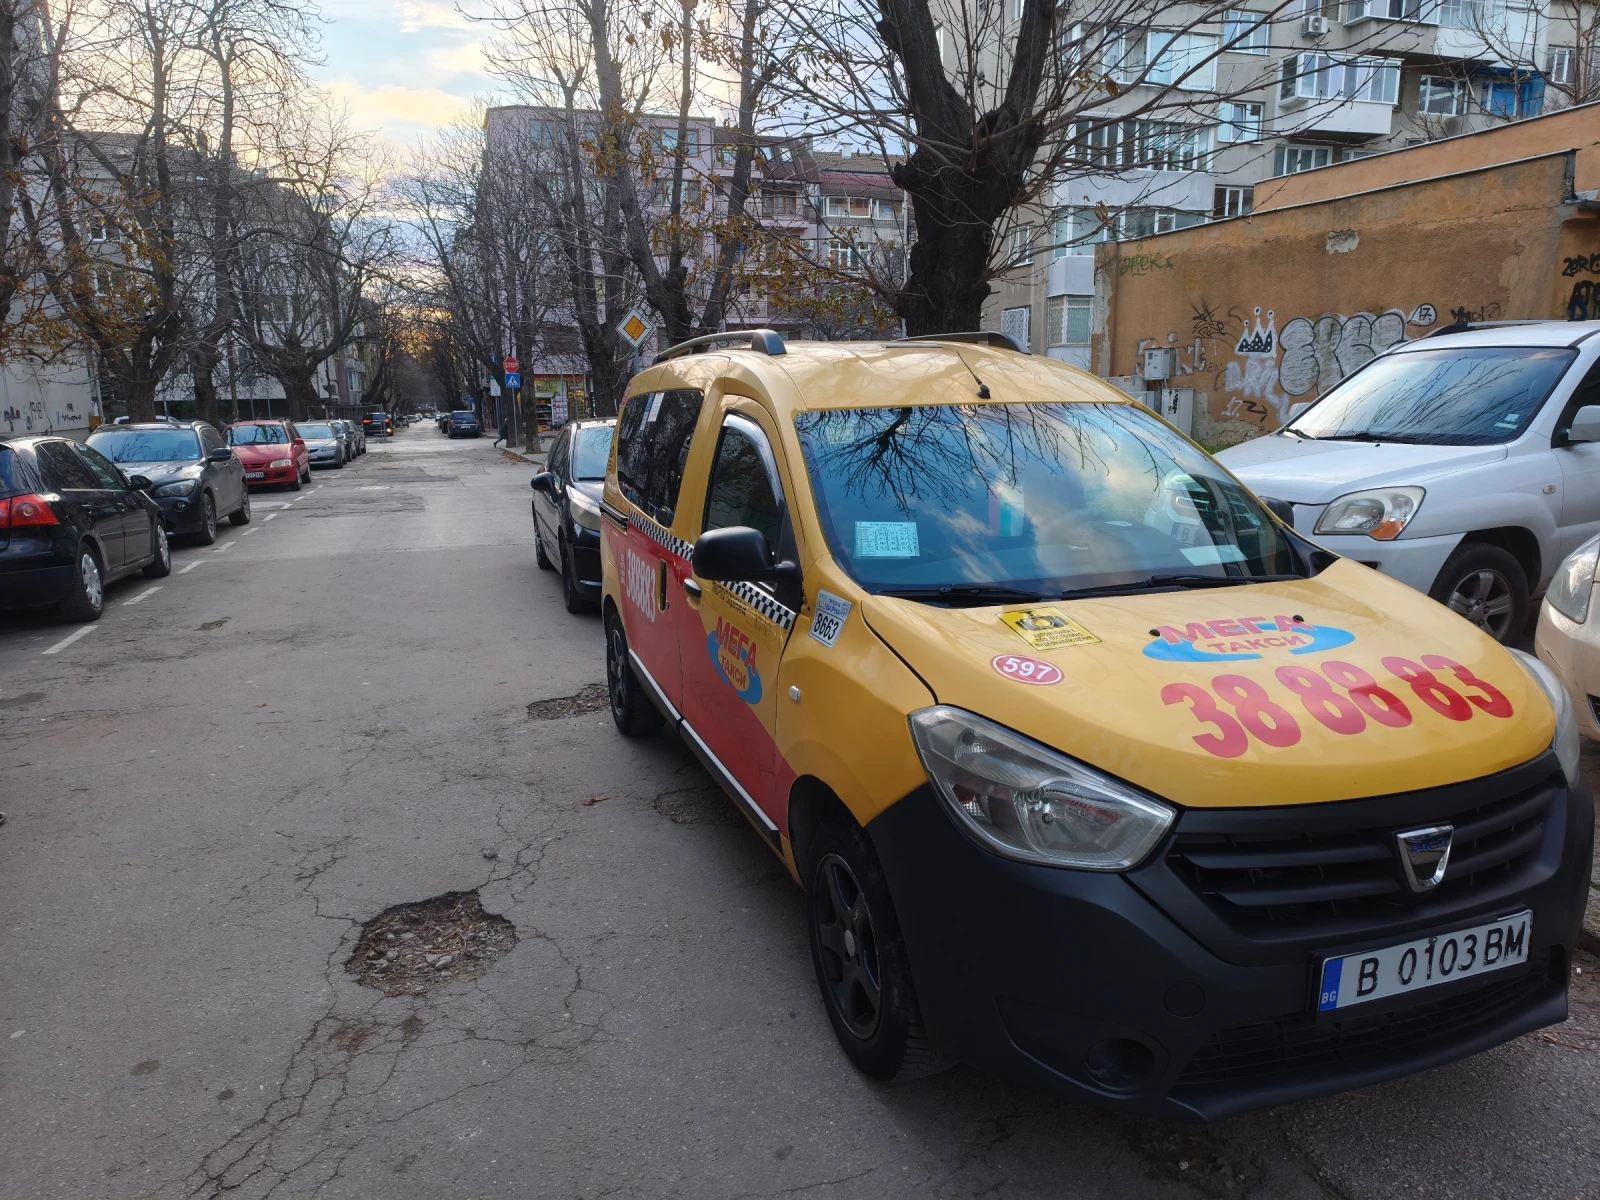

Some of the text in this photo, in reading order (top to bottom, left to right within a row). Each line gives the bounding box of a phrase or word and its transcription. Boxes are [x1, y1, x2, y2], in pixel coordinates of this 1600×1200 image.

[504, 361, 519, 369] STOP
[825, 603, 840, 614] ВАРНА
[813, 612, 840, 641] 8663
[1157, 615, 1317, 645] МЕГА
[715, 615, 758, 675] МЕГА
[1207, 635, 1309, 654] ТАКСИ
[720, 654, 747, 690] ТАКСИ
[1002, 657, 1053, 681] 597
[1320, 990, 1338, 1004] BG
[1357, 957, 1380, 997] B
[1398, 935, 1478, 984] 0103
